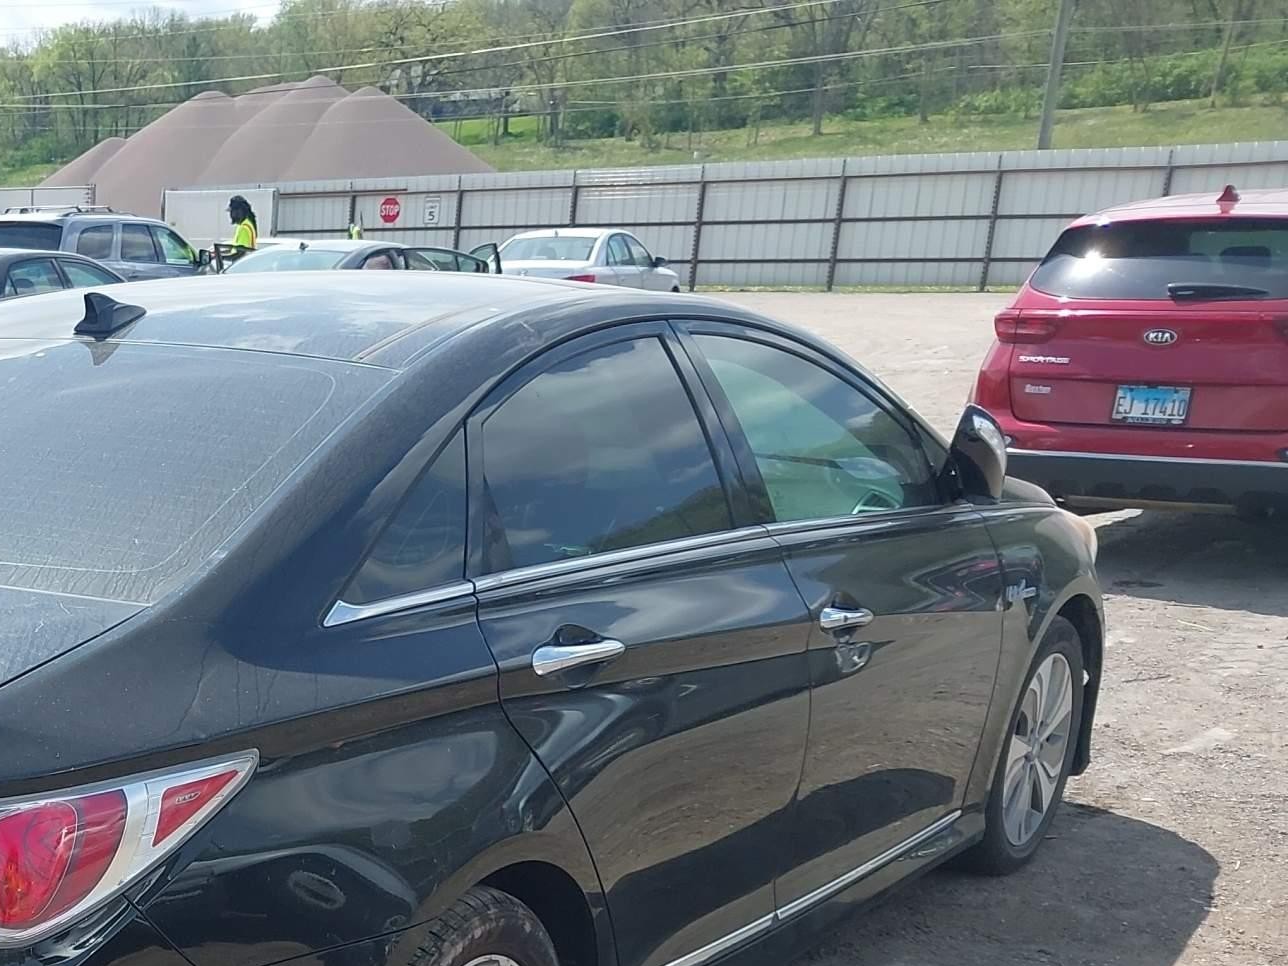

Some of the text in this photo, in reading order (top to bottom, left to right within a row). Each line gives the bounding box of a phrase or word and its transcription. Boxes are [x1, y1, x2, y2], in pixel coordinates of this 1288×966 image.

[381, 204, 400, 216] STOP
[427, 210, 435, 221] 5
[1148, 332, 1172, 342] KIA
[1141, 397, 1187, 417] 17410
